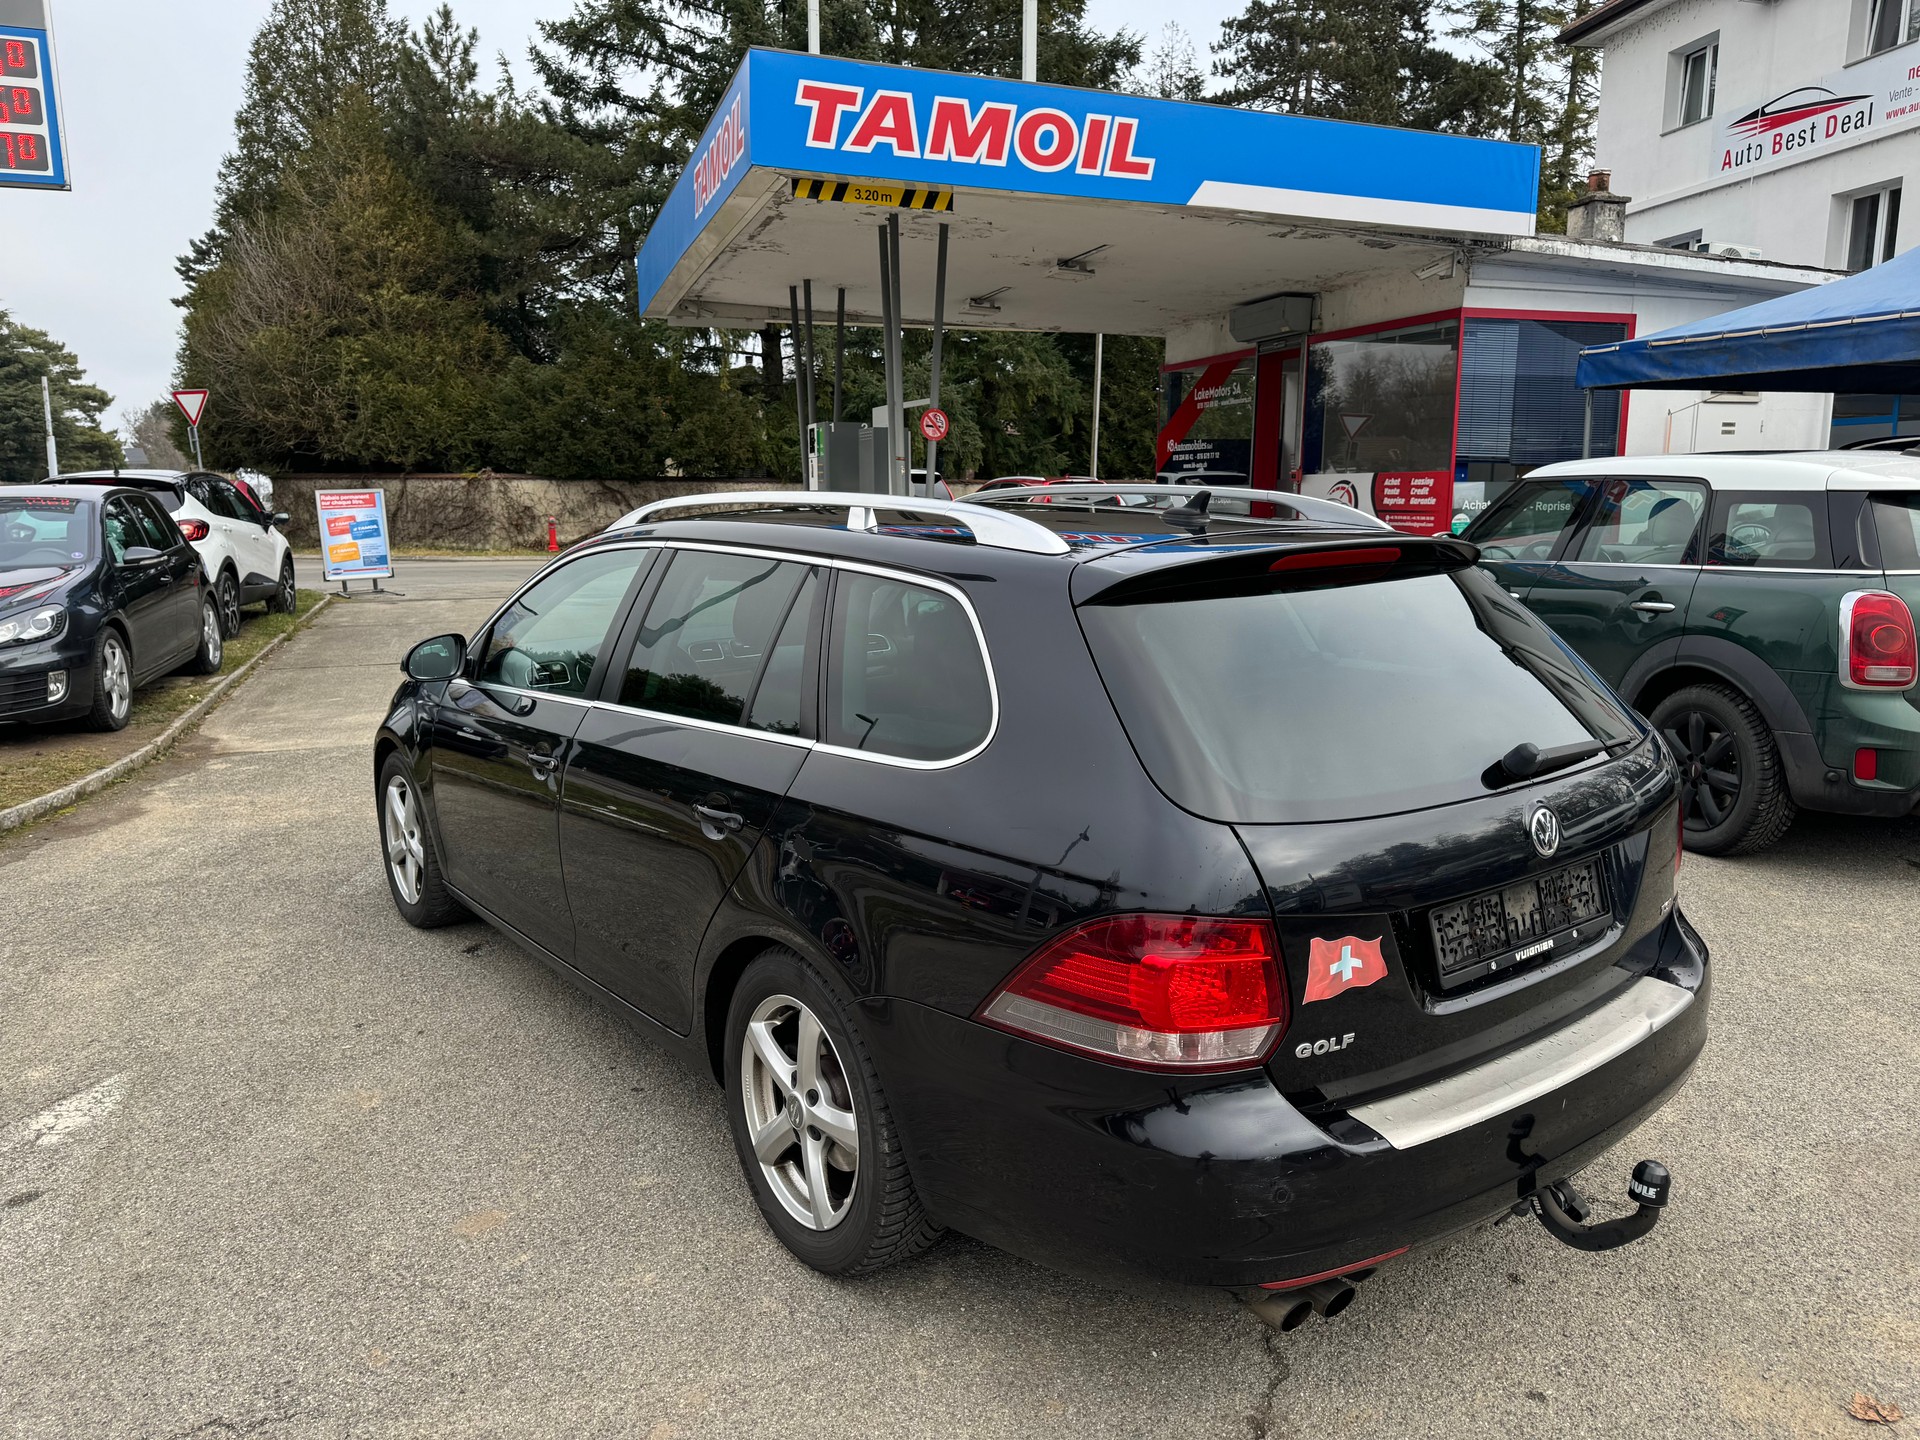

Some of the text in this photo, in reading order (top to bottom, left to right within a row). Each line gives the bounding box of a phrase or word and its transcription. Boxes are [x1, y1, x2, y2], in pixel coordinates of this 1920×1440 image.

[1889, 86, 1913, 102] Vente
[795, 79, 1156, 180] TAMOIL
[1721, 102, 1874, 171] Auto Best Deal
[694, 92, 745, 220] TAMOIL
[854, 188, 892, 203] 3.20 m
[1194, 382, 1241, 400] LakeMotors SA
[1383, 478, 1401, 486] Achat
[1410, 477, 1435, 487] Leasing
[1383, 497, 1405, 506] Reprise
[1409, 497, 1437, 505] Garantie
[1535, 501, 1571, 513] Reprise
[1295, 1032, 1356, 1059] GOLF
